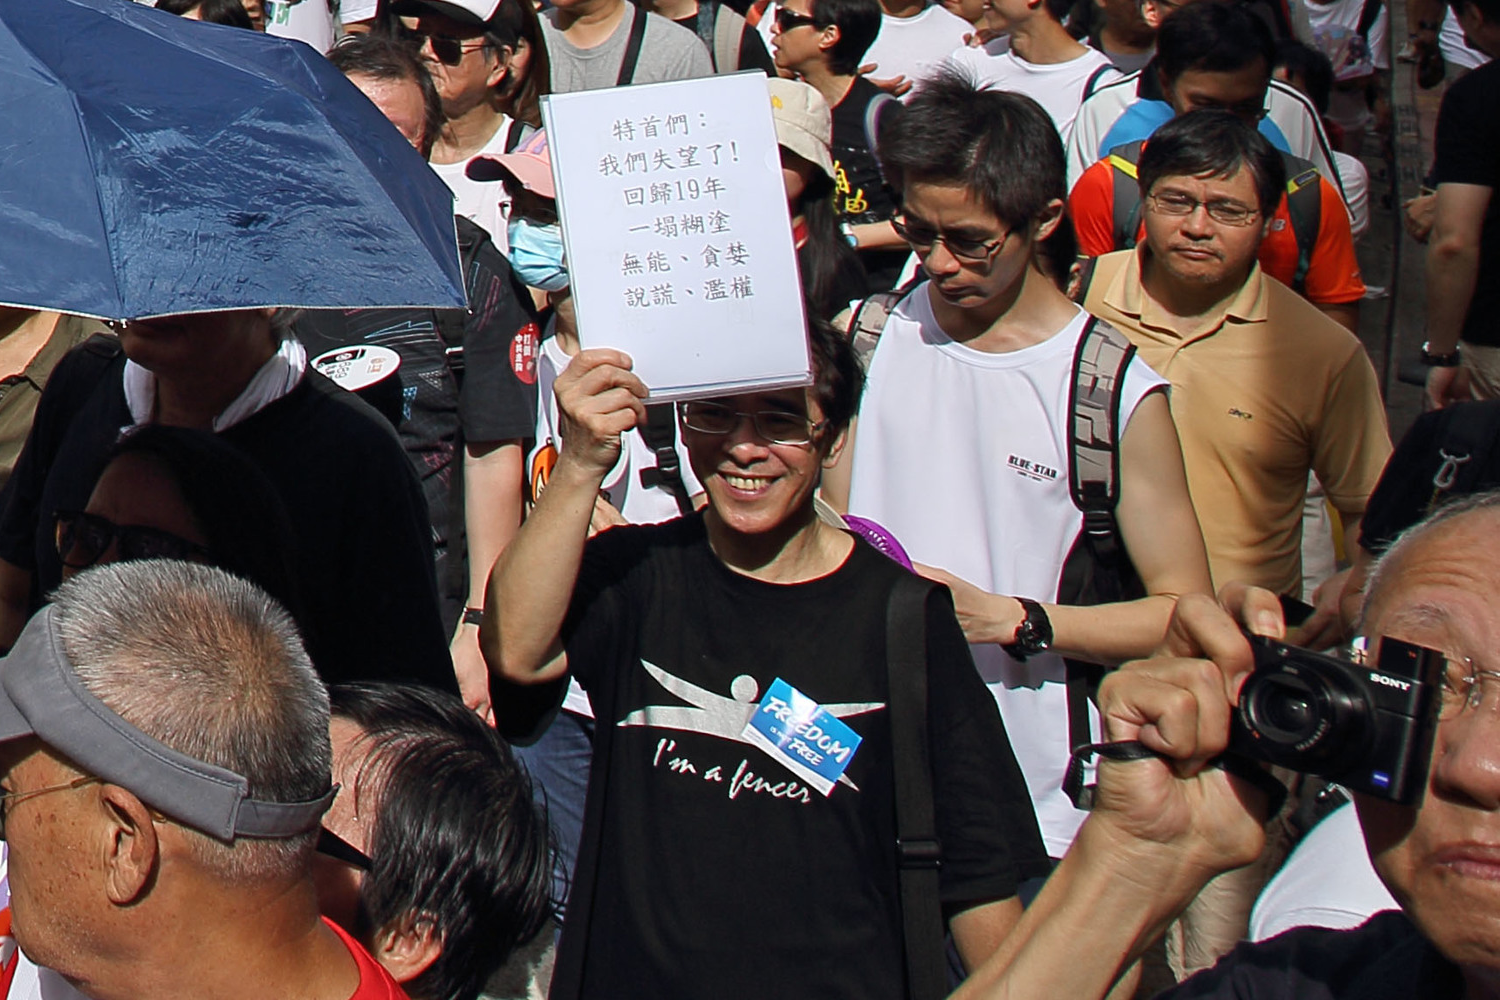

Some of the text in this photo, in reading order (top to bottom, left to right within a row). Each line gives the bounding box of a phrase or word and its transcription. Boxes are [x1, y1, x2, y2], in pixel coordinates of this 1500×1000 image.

[612, 112, 708, 141] 特首們：
[600, 141, 739, 176] 我們失望了！
[624, 177, 726, 206] 回歸19年
[629, 210, 731, 239] 一塌糊塗
[621, 242, 751, 276] 無能、貪婪
[624, 275, 754, 308] 說謊、濫權
[1369, 672, 1411, 691] SONY
[762, 695, 851, 764] FREEDOM
[788, 737, 825, 767] FREE
[653, 738, 811, 804] I'm a fencer
